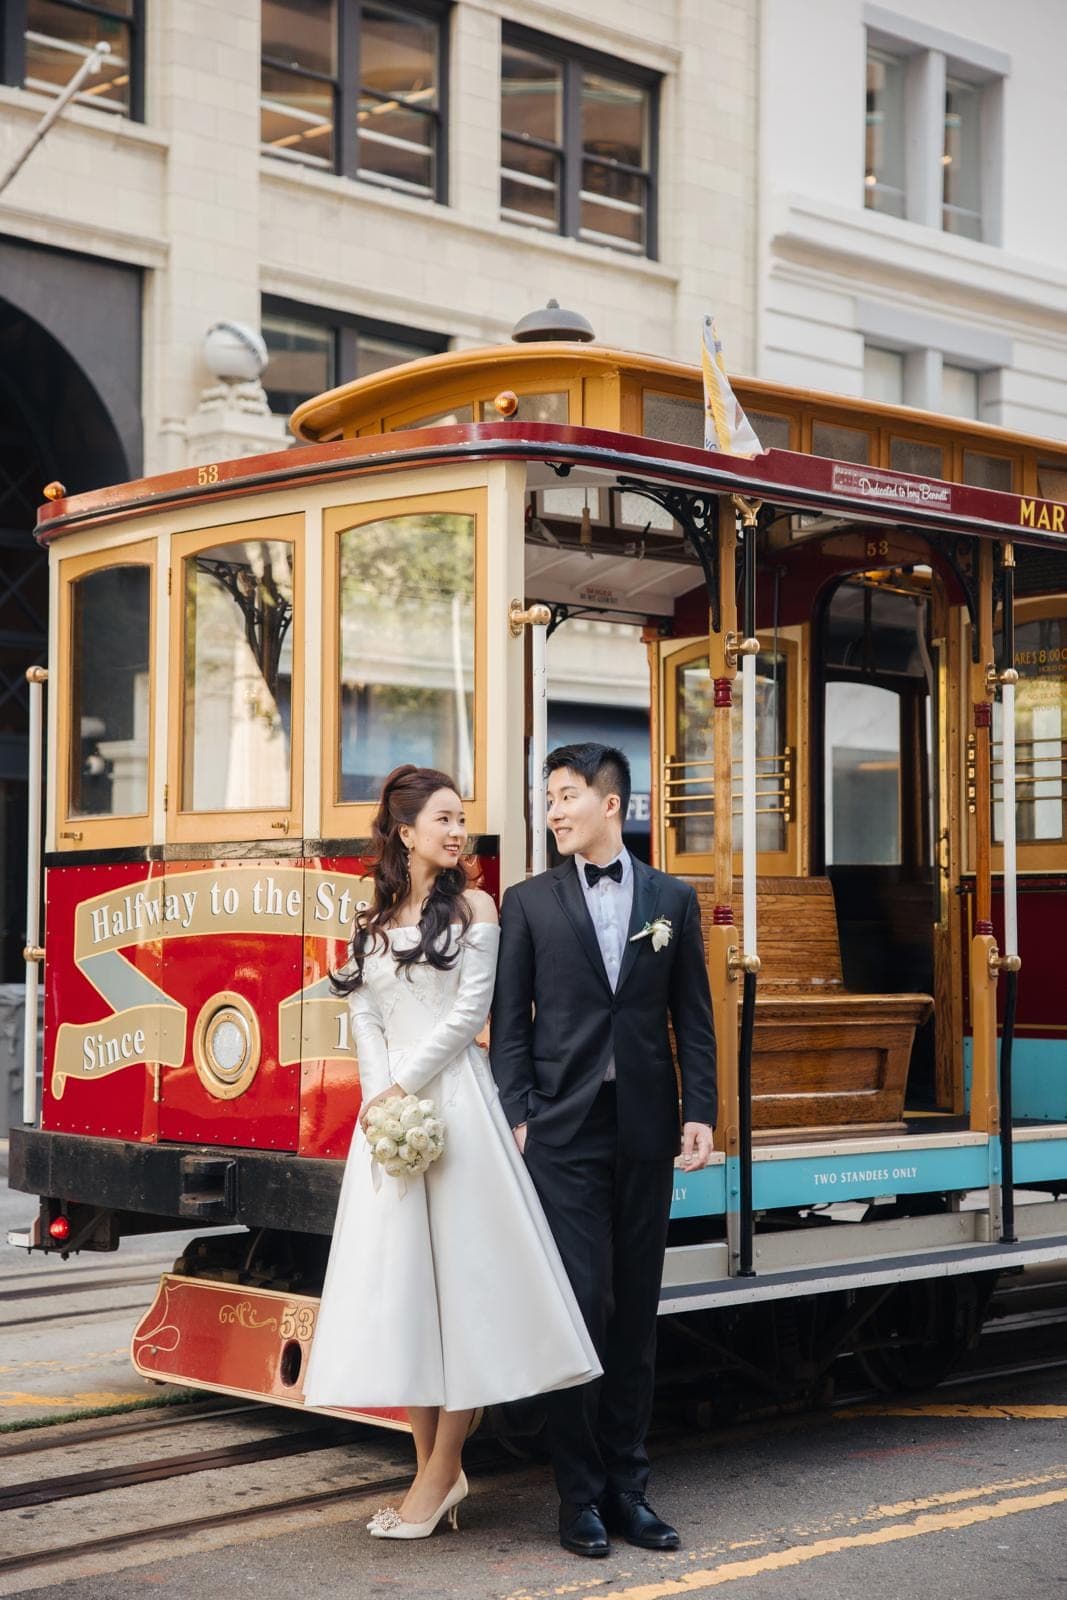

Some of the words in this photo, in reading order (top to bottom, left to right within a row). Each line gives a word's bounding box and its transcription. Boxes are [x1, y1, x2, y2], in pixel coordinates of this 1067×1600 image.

[198, 464, 219, 486] 53
[859, 478, 898, 497] Dedicated
[1020, 499, 1065, 532] MAR
[866, 541, 889, 556] 53
[1014, 651, 1037, 664] ARES
[90, 891, 198, 943] Halfway
[210, 881, 240, 915] to
[252, 877, 301, 916] the
[82, 1028, 145, 1071] Since
[814, 1173, 837, 1185] TWO
[841, 1169, 888, 1183] STANDEES
[892, 1167, 918, 1178] ONLY
[279, 1306, 315, 1341] 53
